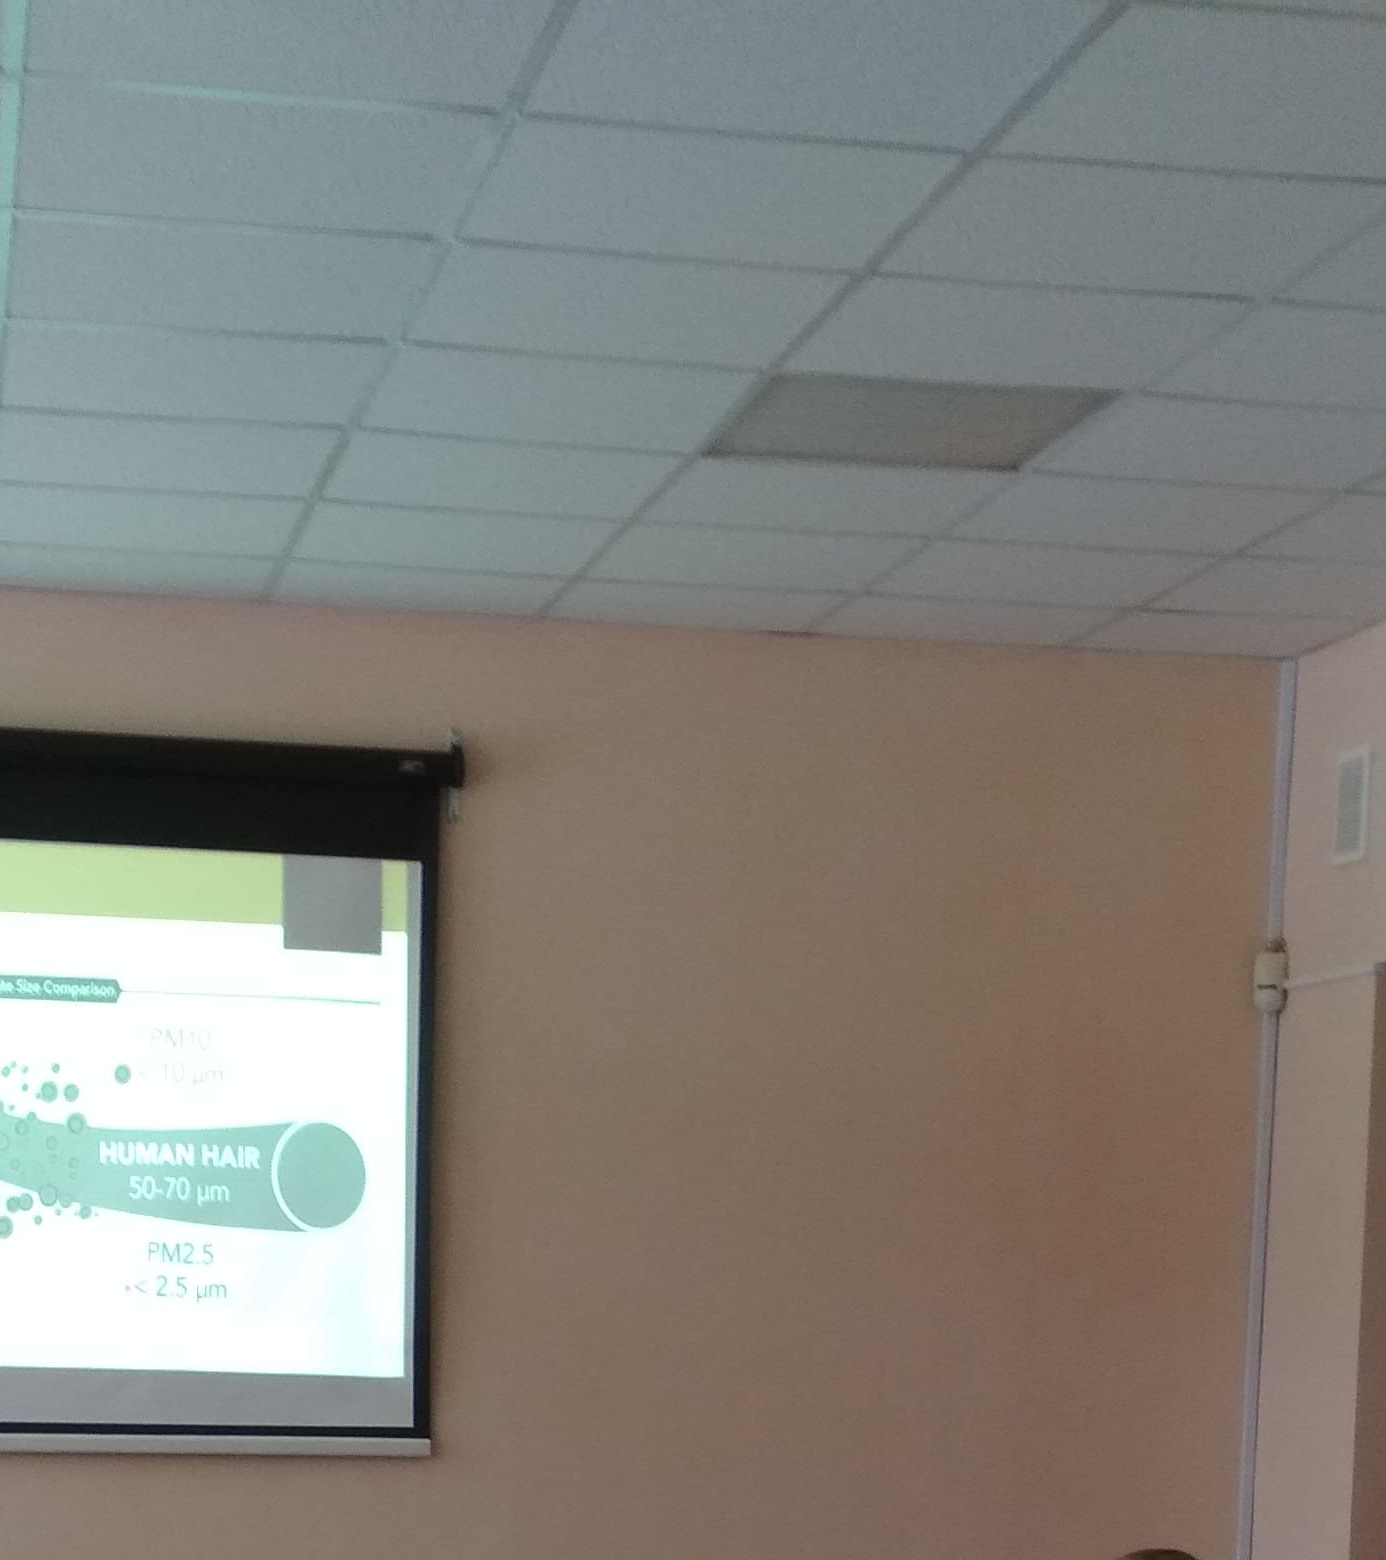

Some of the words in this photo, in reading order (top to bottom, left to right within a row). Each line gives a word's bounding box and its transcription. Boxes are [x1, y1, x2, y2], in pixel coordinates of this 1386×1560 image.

[16, 979, 41, 994] Size
[43, 979, 116, 1000] Comparison
[150, 1027, 212, 1051] PM10
[99, 1140, 195, 1166] HUMAN
[201, 1143, 261, 1169] HAIR
[128, 1175, 191, 1200] 50-70
[148, 1242, 214, 1265] PM2.5
[156, 1275, 187, 1298] 2.5
